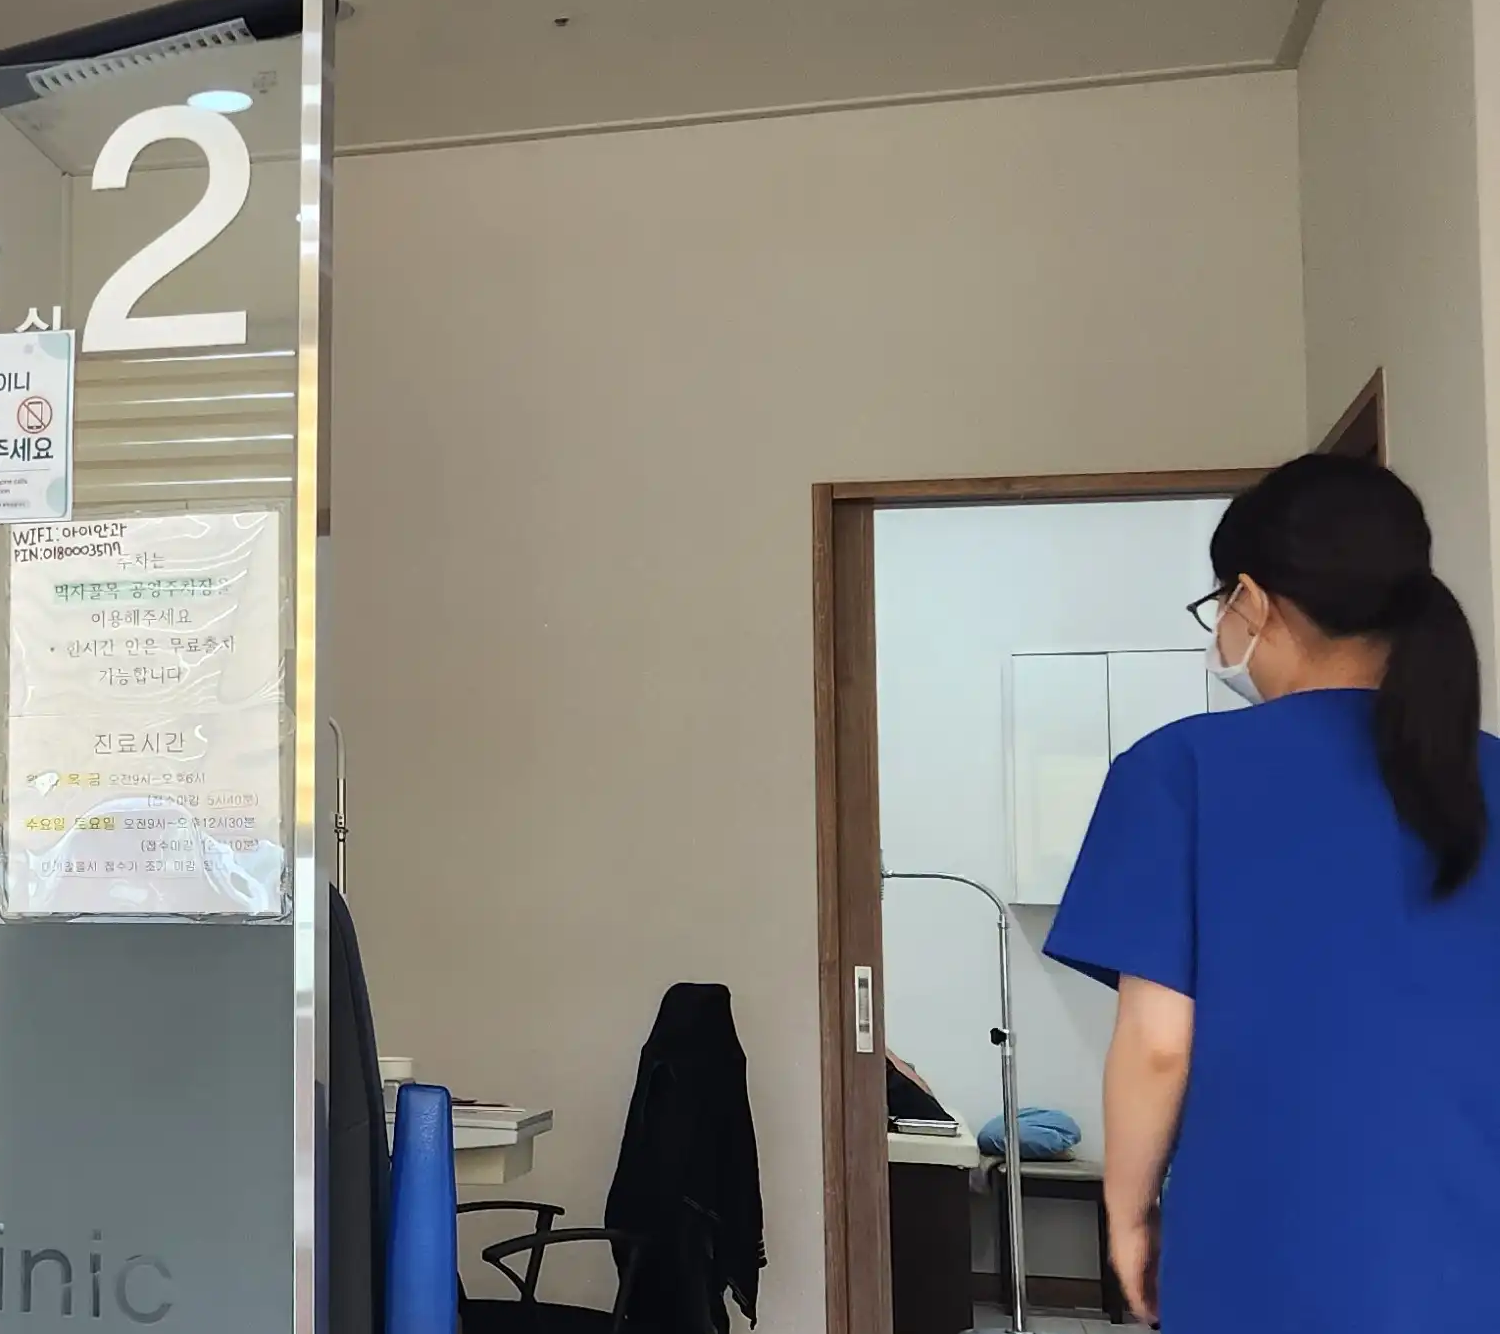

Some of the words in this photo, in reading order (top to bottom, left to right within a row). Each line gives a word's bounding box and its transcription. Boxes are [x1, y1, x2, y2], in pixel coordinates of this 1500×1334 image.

[81, 104, 252, 353] 2
[13, 477, 28, 485] calls
[54, 582, 121, 601] 먹자골목
[91, 608, 193, 629] 이용해주세요
[99, 666, 184, 686] 가능합니다
[93, 732, 187, 755] 진료시간
[87, 772, 101, 786] 금
[26, 817, 66, 830] 수요일
[74, 817, 116, 831] 토요일
